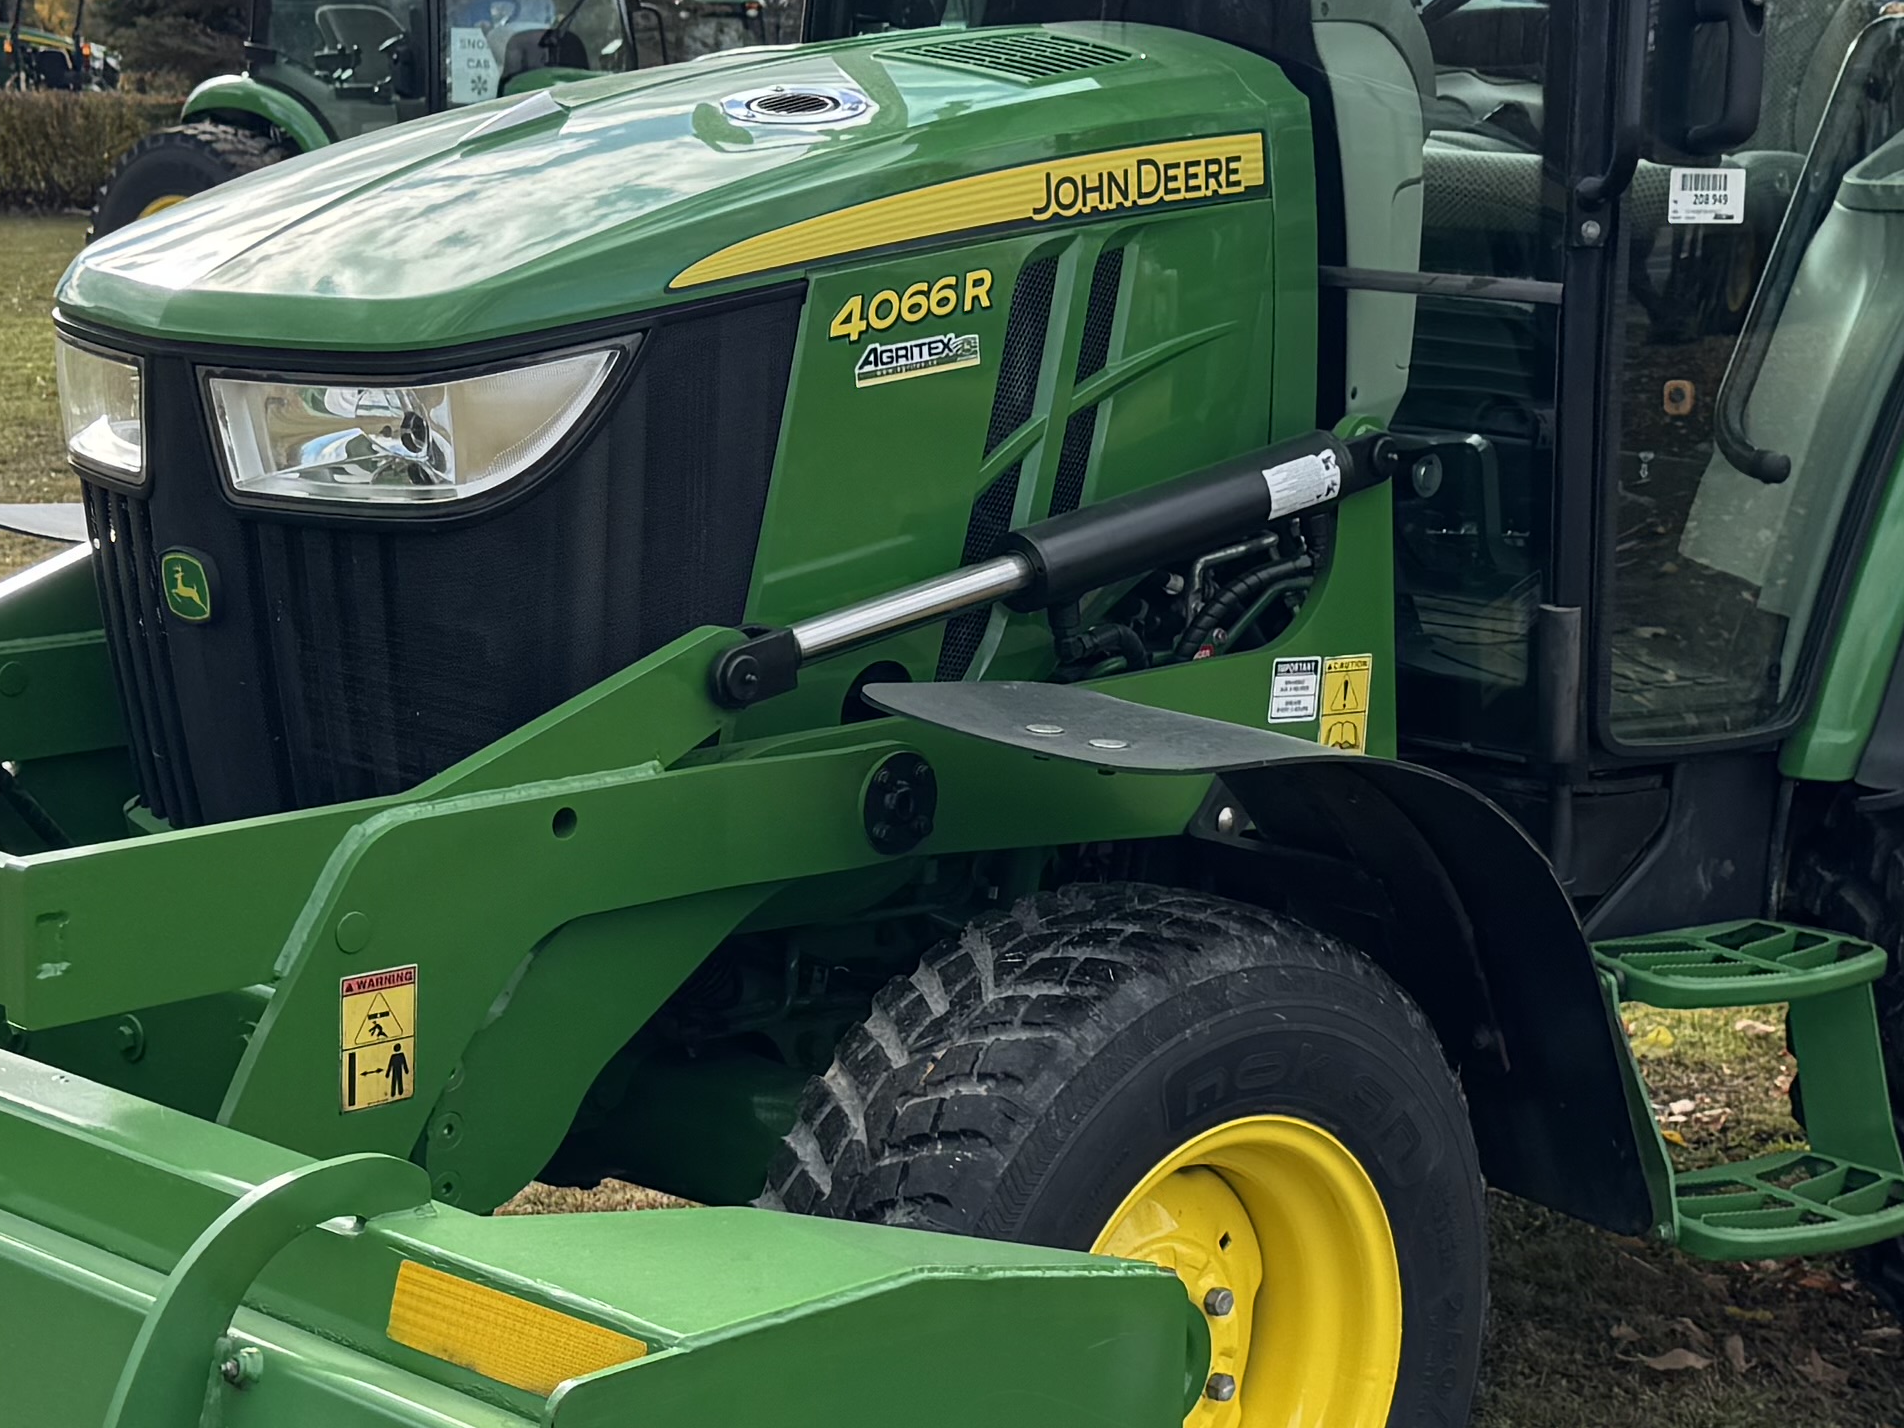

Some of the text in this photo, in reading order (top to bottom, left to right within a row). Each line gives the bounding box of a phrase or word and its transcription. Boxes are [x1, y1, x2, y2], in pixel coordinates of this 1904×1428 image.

[459, 38, 491, 49] SNO
[1032, 156, 1242, 215] JOHN DEERE
[1692, 193, 1728, 205] 208 949
[858, 337, 954, 370] AGRITEX
[1333, 660, 1368, 670] CAUTION
[356, 970, 413, 990] WARNING
